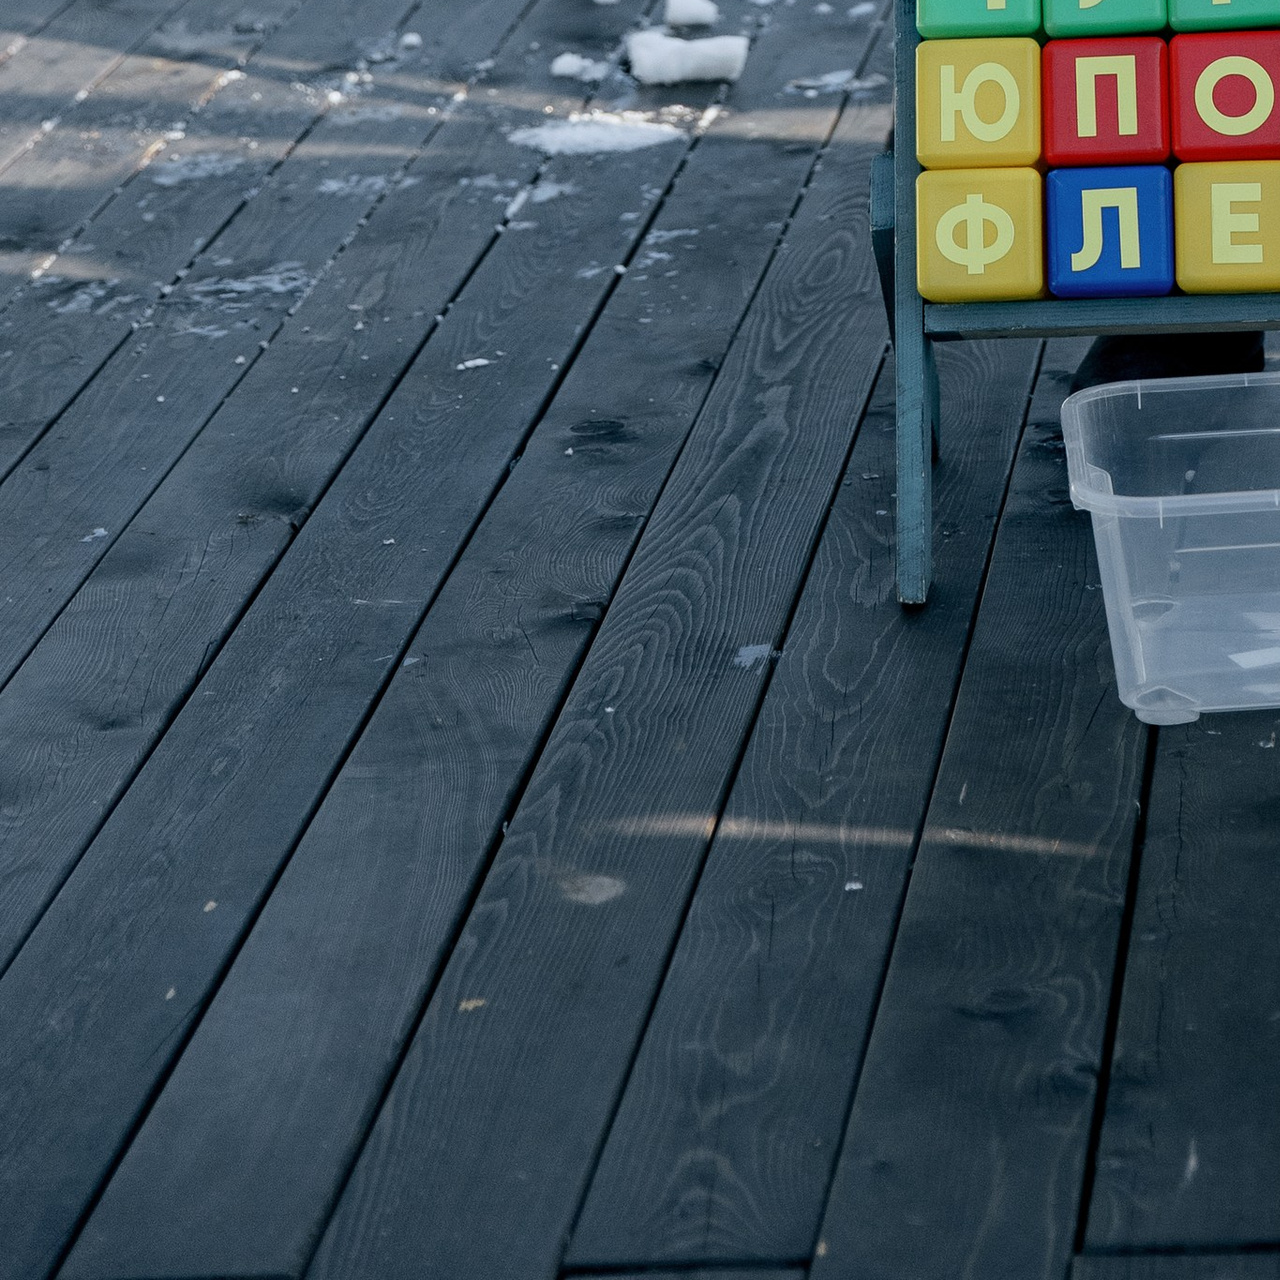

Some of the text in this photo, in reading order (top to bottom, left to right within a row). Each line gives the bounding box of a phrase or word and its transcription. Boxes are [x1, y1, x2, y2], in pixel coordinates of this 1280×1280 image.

[940, 63, 1021, 142] Ю
[1075, 56, 1137, 137] П
[1196, 56, 1275, 136] О
[935, 193, 1014, 274] Ф
[1071, 188, 1140, 270] Л
[1212, 183, 1264, 264] Е
